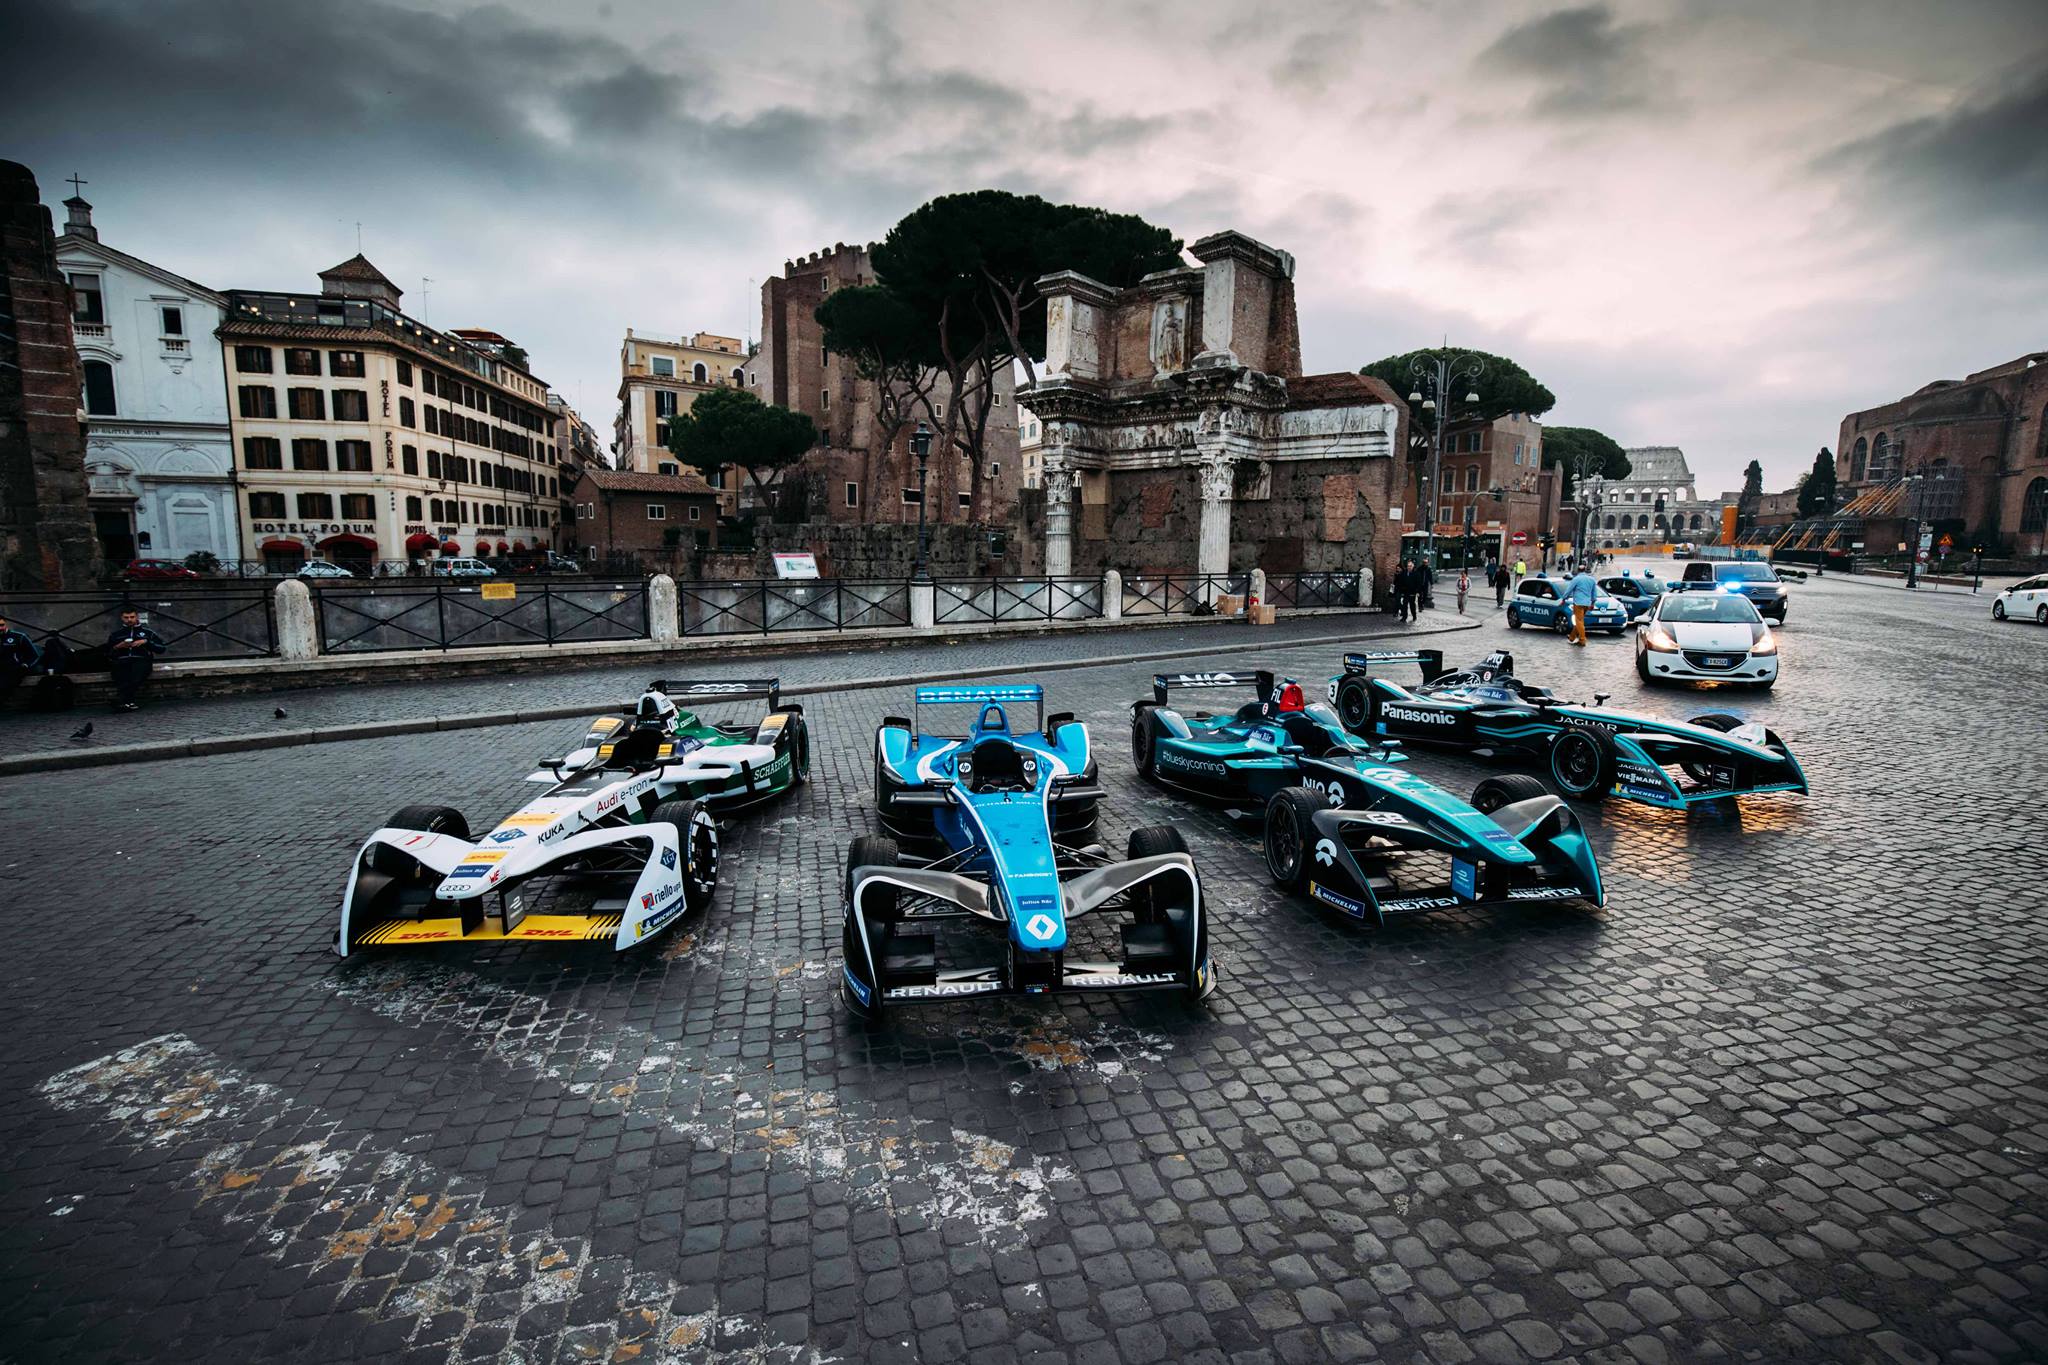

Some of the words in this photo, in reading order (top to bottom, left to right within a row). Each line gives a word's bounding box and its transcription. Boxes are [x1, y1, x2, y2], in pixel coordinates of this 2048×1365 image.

[380, 379, 390, 418] HOTEL
[385, 431, 394, 469] FORUM
[253, 523, 309, 533] HOTEL
[321, 524, 375, 534] FORUM
[1520, 605, 1549, 616] POLIZIA
[1179, 673, 1237, 687] NIO
[920, 689, 1035, 700] RENAULT
[1329, 684, 1336, 698] 3
[1381, 702, 1456, 725] Panasonic
[1555, 716, 1618, 732] JAGUAR
[1162, 750, 1226, 775] #blueskycoming
[1618, 763, 1655, 774] JAGUAR
[597, 792, 618, 814] Audi
[620, 779, 648, 800] e-tron
[1629, 788, 1665, 800] MICHELIN
[537, 823, 565, 844] KUKA
[662, 853, 676, 865] LGT
[654, 884, 673, 905] riello
[1322, 893, 1359, 912] MICHELIN
[1385, 896, 1459, 912] NEXTEV
[653, 901, 682, 925] MICHELIN
[1070, 972, 1177, 985] RENAULT
[890, 981, 1002, 998] RENAULT
